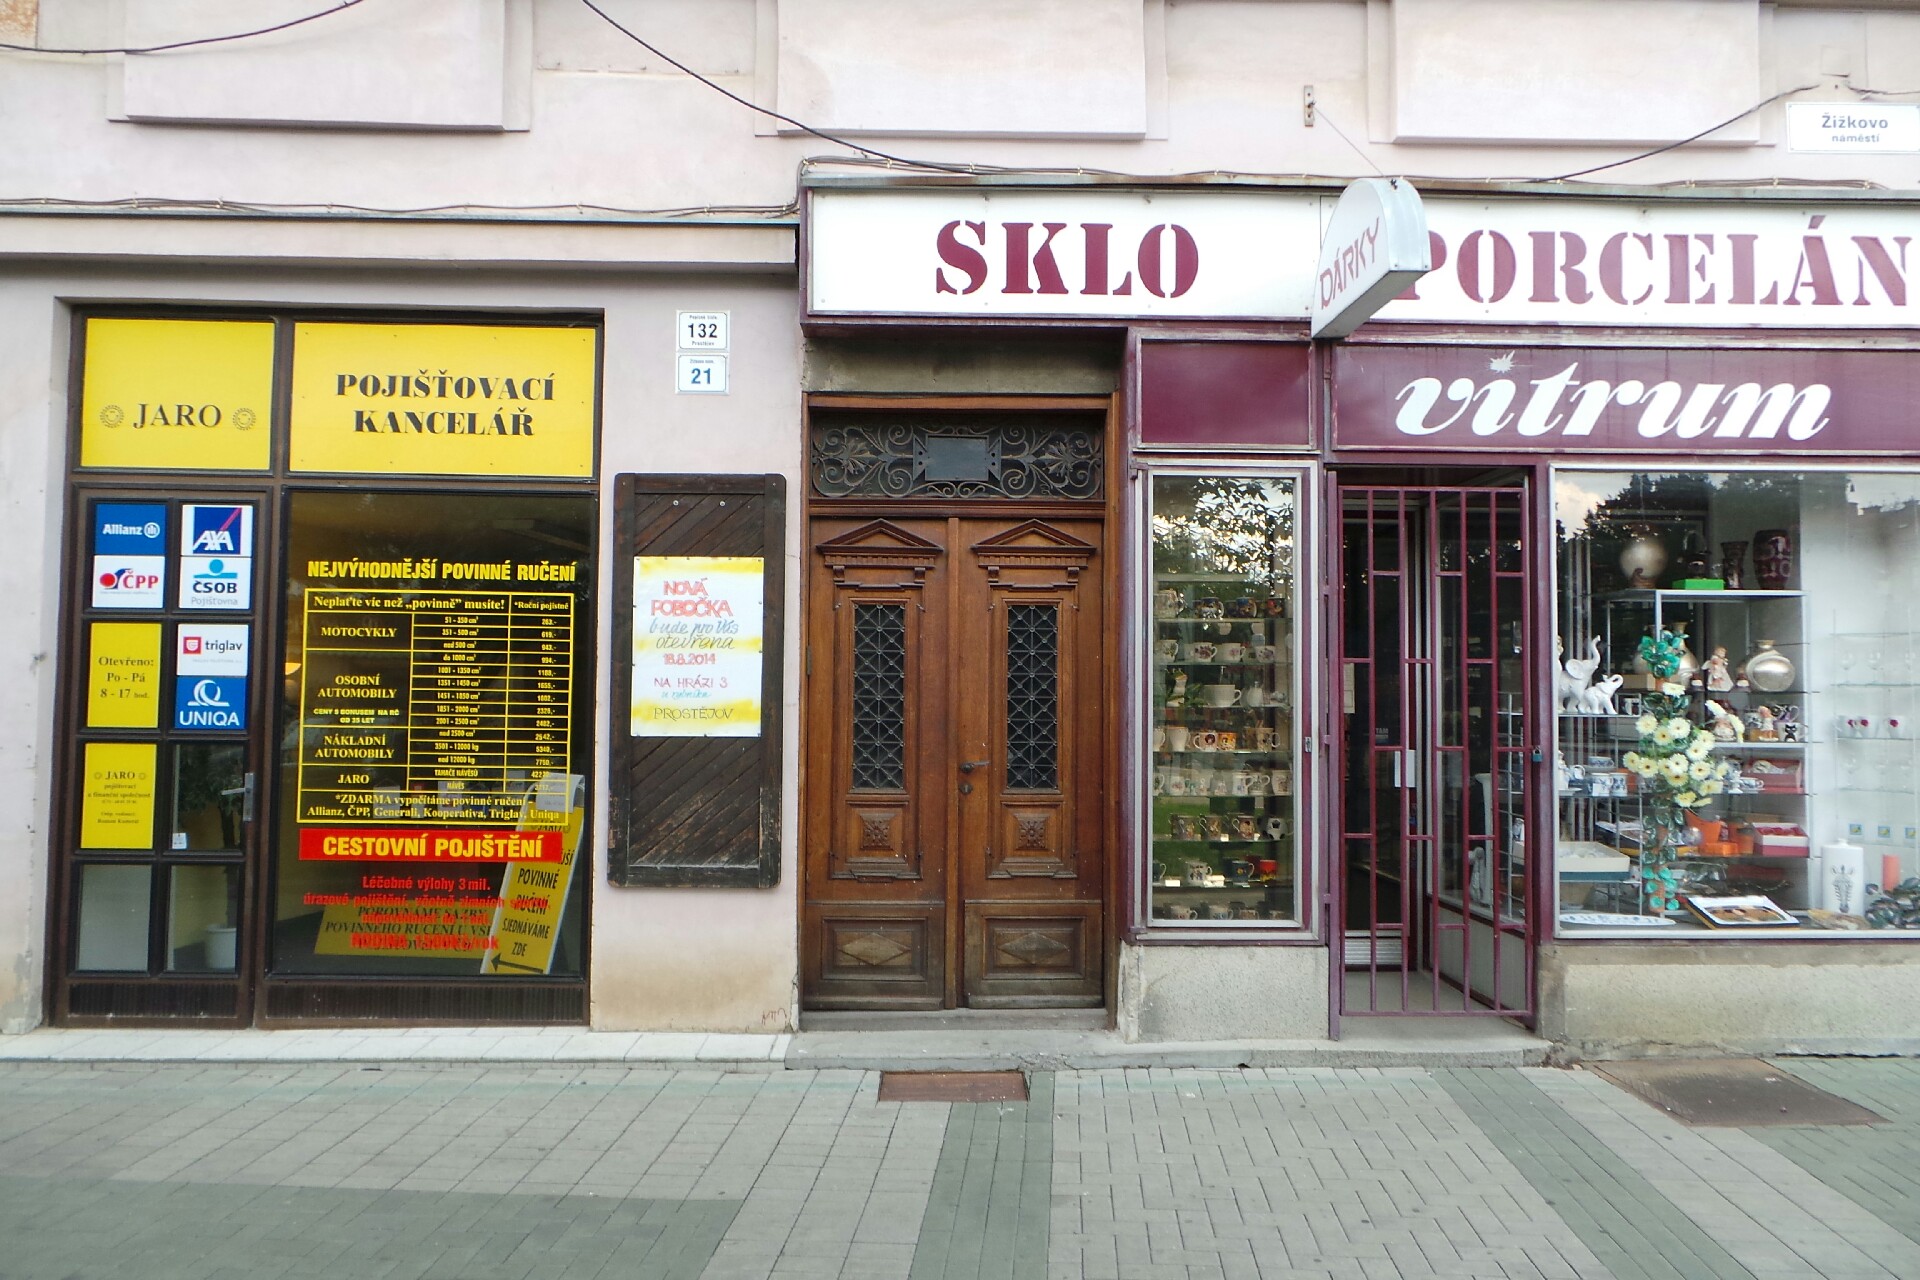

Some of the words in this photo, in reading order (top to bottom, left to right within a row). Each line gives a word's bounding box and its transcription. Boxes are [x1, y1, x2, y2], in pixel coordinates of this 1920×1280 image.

[1821, 112, 1888, 129] Žižkovo
[1831, 134, 1881, 142] náměstí
[936, 219, 1199, 299] SKLO
[1319, 217, 1380, 310] DÁRKY
[688, 323, 717, 338] 132
[691, 367, 711, 384] 21
[335, 369, 556, 401] POJIŠŤOVACÍ
[1395, 351, 1832, 440] vitrum
[133, 403, 222, 429] JARO
[353, 406, 535, 437] KANCELÁŘ
[102, 524, 143, 536] Allianz
[193, 530, 234, 551] AXA
[307, 557, 438, 579] NEJVÝHODNĚJŠÍ
[442, 560, 511, 580] POVINNÉ
[517, 561, 577, 581] RUČENÍ
[123, 569, 159, 589] ČPP
[193, 580, 238, 594] ČSOB
[663, 577, 709, 597] NOVÁ
[190, 596, 239, 606] Pojišťovna
[365, 597, 381, 608] víc
[384, 597, 404, 608] než
[464, 599, 505, 610] musíte!
[540, 602, 569, 610] pojistné
[651, 597, 734, 618] POBOČKA
[321, 627, 397, 637] MOTOCYKLY
[649, 617, 689, 635] bude
[690, 625, 713, 640] pro
[714, 618, 739, 634] Vás
[204, 635, 243, 654] triglav
[655, 634, 736, 650] otevřena
[98, 655, 155, 666] Otevřeno:
[106, 672, 121, 682] Po
[132, 671, 146, 682] Pá
[335, 673, 381, 686] OSOBNÍ
[653, 677, 671, 688] NA
[719, 676, 728, 688] 3
[100, 689, 108, 698] 8
[118, 689, 131, 699] 17
[317, 688, 397, 698] AUTOMOBILY
[179, 711, 240, 727] UNIQA
[653, 705, 734, 722] PROSTĚJOV
[324, 733, 386, 746] NÁKLADNÍ
[315, 748, 394, 759] AUTOMOBILY
[105, 771, 136, 780] JARO
[337, 774, 370, 784] JARO
[394, 794, 451, 806] vypočítáme
[453, 796, 492, 807] povinné
[307, 806, 345, 817] Allianz,
[347, 805, 371, 817] ČPP,
[374, 807, 421, 818] Generali,
[423, 808, 487, 820] Kooperativa,
[530, 809, 560, 820] Uniqa
[323, 833, 429, 857] CESTOVNÍ
[434, 834, 544, 858] POJIŠTĚNÍ
[362, 876, 413, 889] Léčebné
[417, 877, 454, 892] výlohy
[458, 878, 466, 889] 3
[467, 878, 491, 890] mil.
[517, 868, 560, 890] POVINNÉ
[303, 892, 349, 905] úrazové
[502, 918, 551, 939] SJEDNÁVÁME
[511, 942, 527, 957] ZDE
